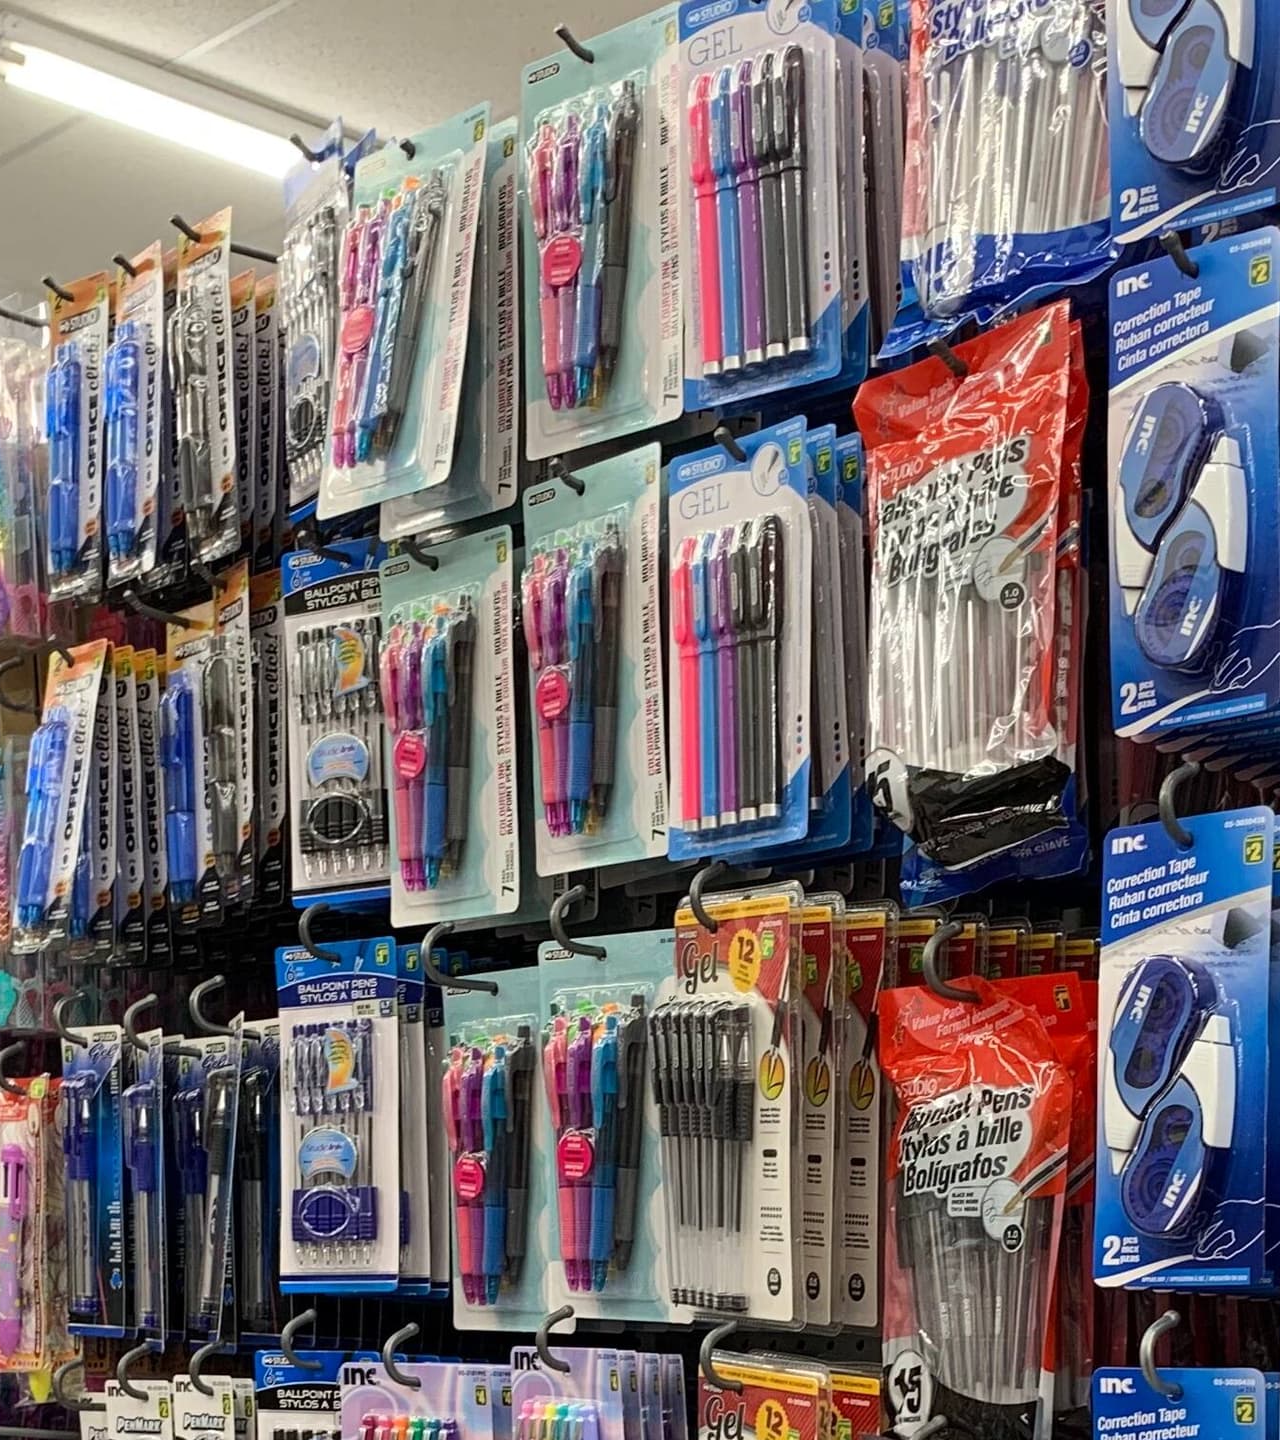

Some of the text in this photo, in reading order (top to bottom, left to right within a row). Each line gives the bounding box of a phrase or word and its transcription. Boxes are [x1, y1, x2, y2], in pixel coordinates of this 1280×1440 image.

[688, 27, 742, 66] GEL
[1121, 188, 1139, 221] 2
[1113, 286, 1201, 336] Correction Tape
[1115, 298, 1215, 355] Ruban correcteur
[1118, 321, 1210, 373] Cinta correctora
[88, 392, 98, 478] OFFICE
[680, 484, 729, 520] GEL
[305, 582, 357, 600] BALLPOINT
[307, 595, 344, 609] STYLOS
[1121, 683, 1139, 716] 2
[268, 698, 278, 787] OFFICE
[64, 758, 83, 839] OFFICE
[99, 766, 109, 850] OFFICE
[123, 768, 135, 853] OFFICE
[145, 770, 157, 854] OFFICE
[1107, 856, 1196, 893] Correction Tape
[1109, 870, 1210, 911] Ruban correcteur
[1111, 892, 1204, 928] Cinta correctora
[682, 940, 718, 993] Gel
[737, 937, 756, 962] 12
[297, 977, 378, 996] BALLPOINT PENS
[300, 988, 377, 1004] STYLOS BILLE
[979, 1087, 1034, 1114] Pens
[977, 1117, 1022, 1146] bille
[905, 1155, 1008, 1193] Bolígrafos
[1103, 1235, 1120, 1265] 2
[764, 1405, 783, 1430] 12
[1098, 1407, 1186, 1431] Correction Tape
